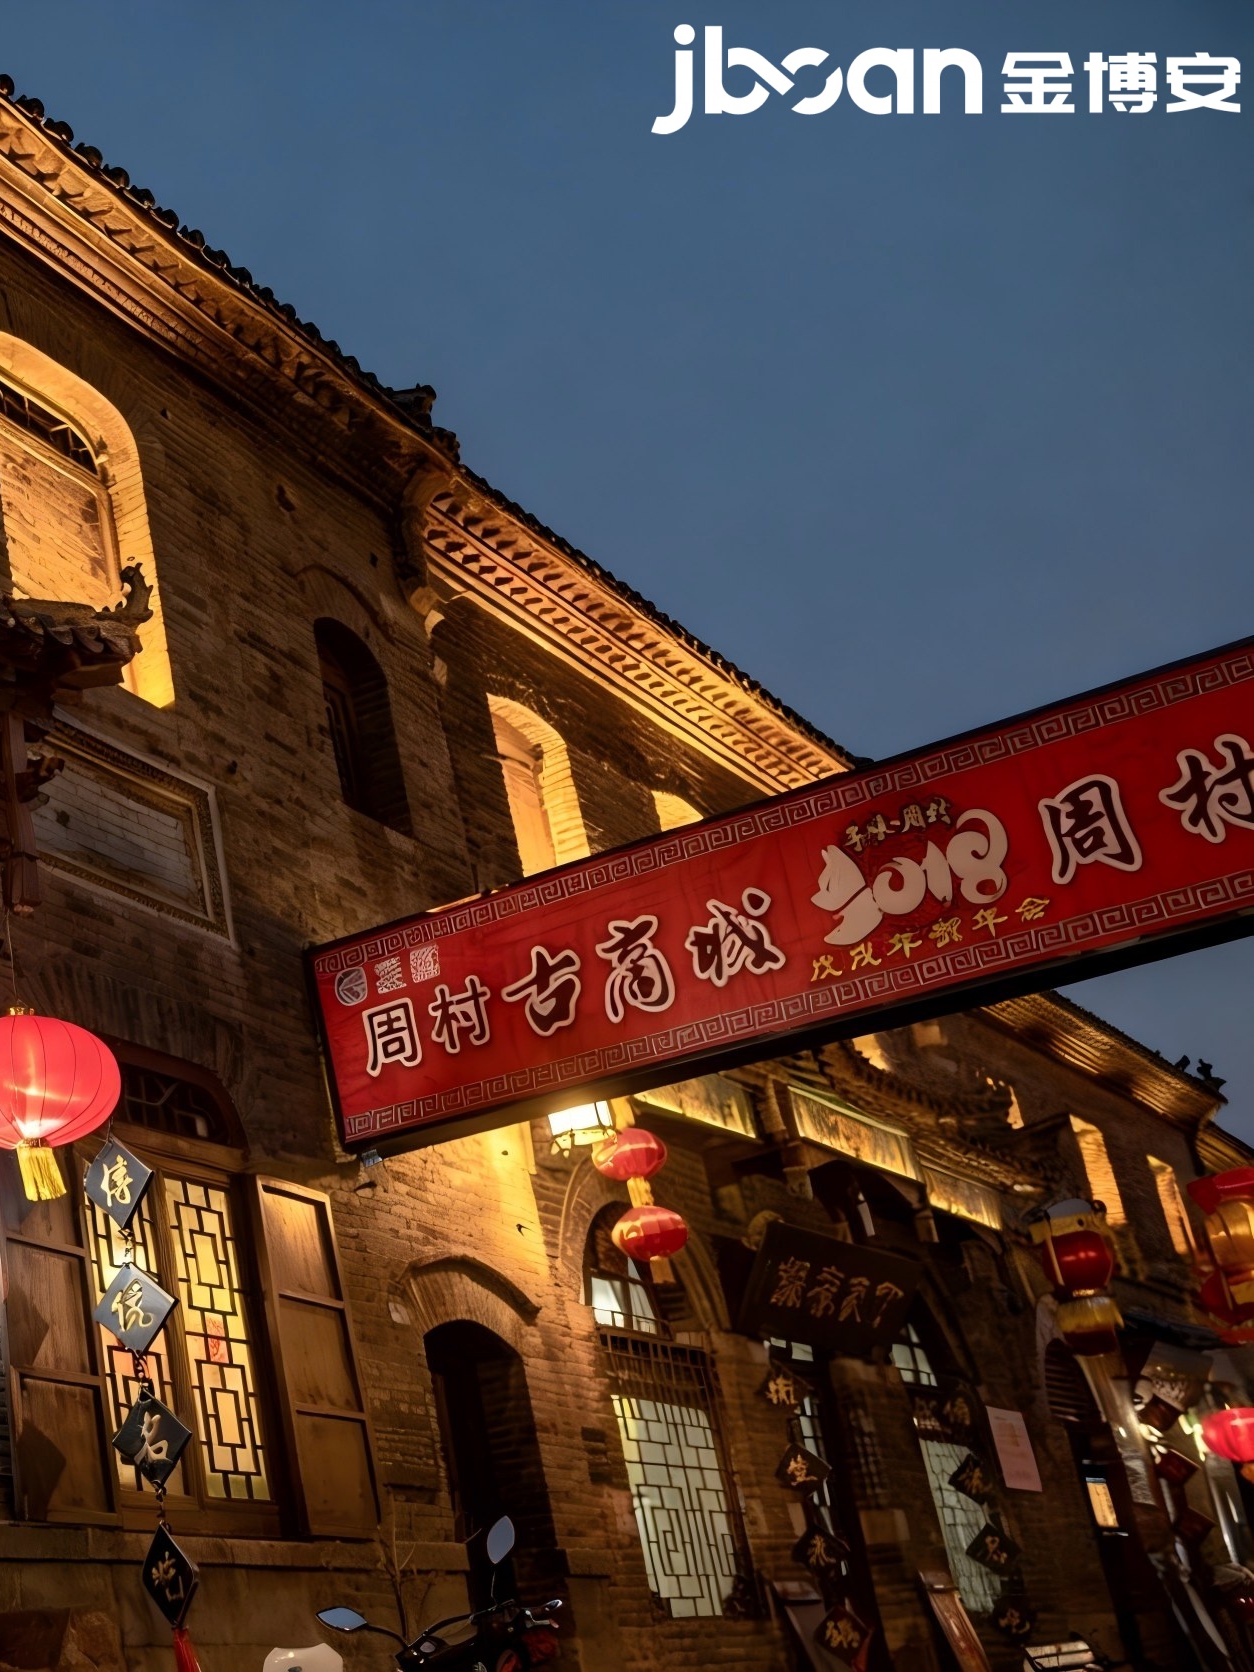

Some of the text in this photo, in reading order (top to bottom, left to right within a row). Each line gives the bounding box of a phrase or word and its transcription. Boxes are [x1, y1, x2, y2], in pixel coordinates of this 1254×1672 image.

[364, 886, 786, 1079] 周村古商城
